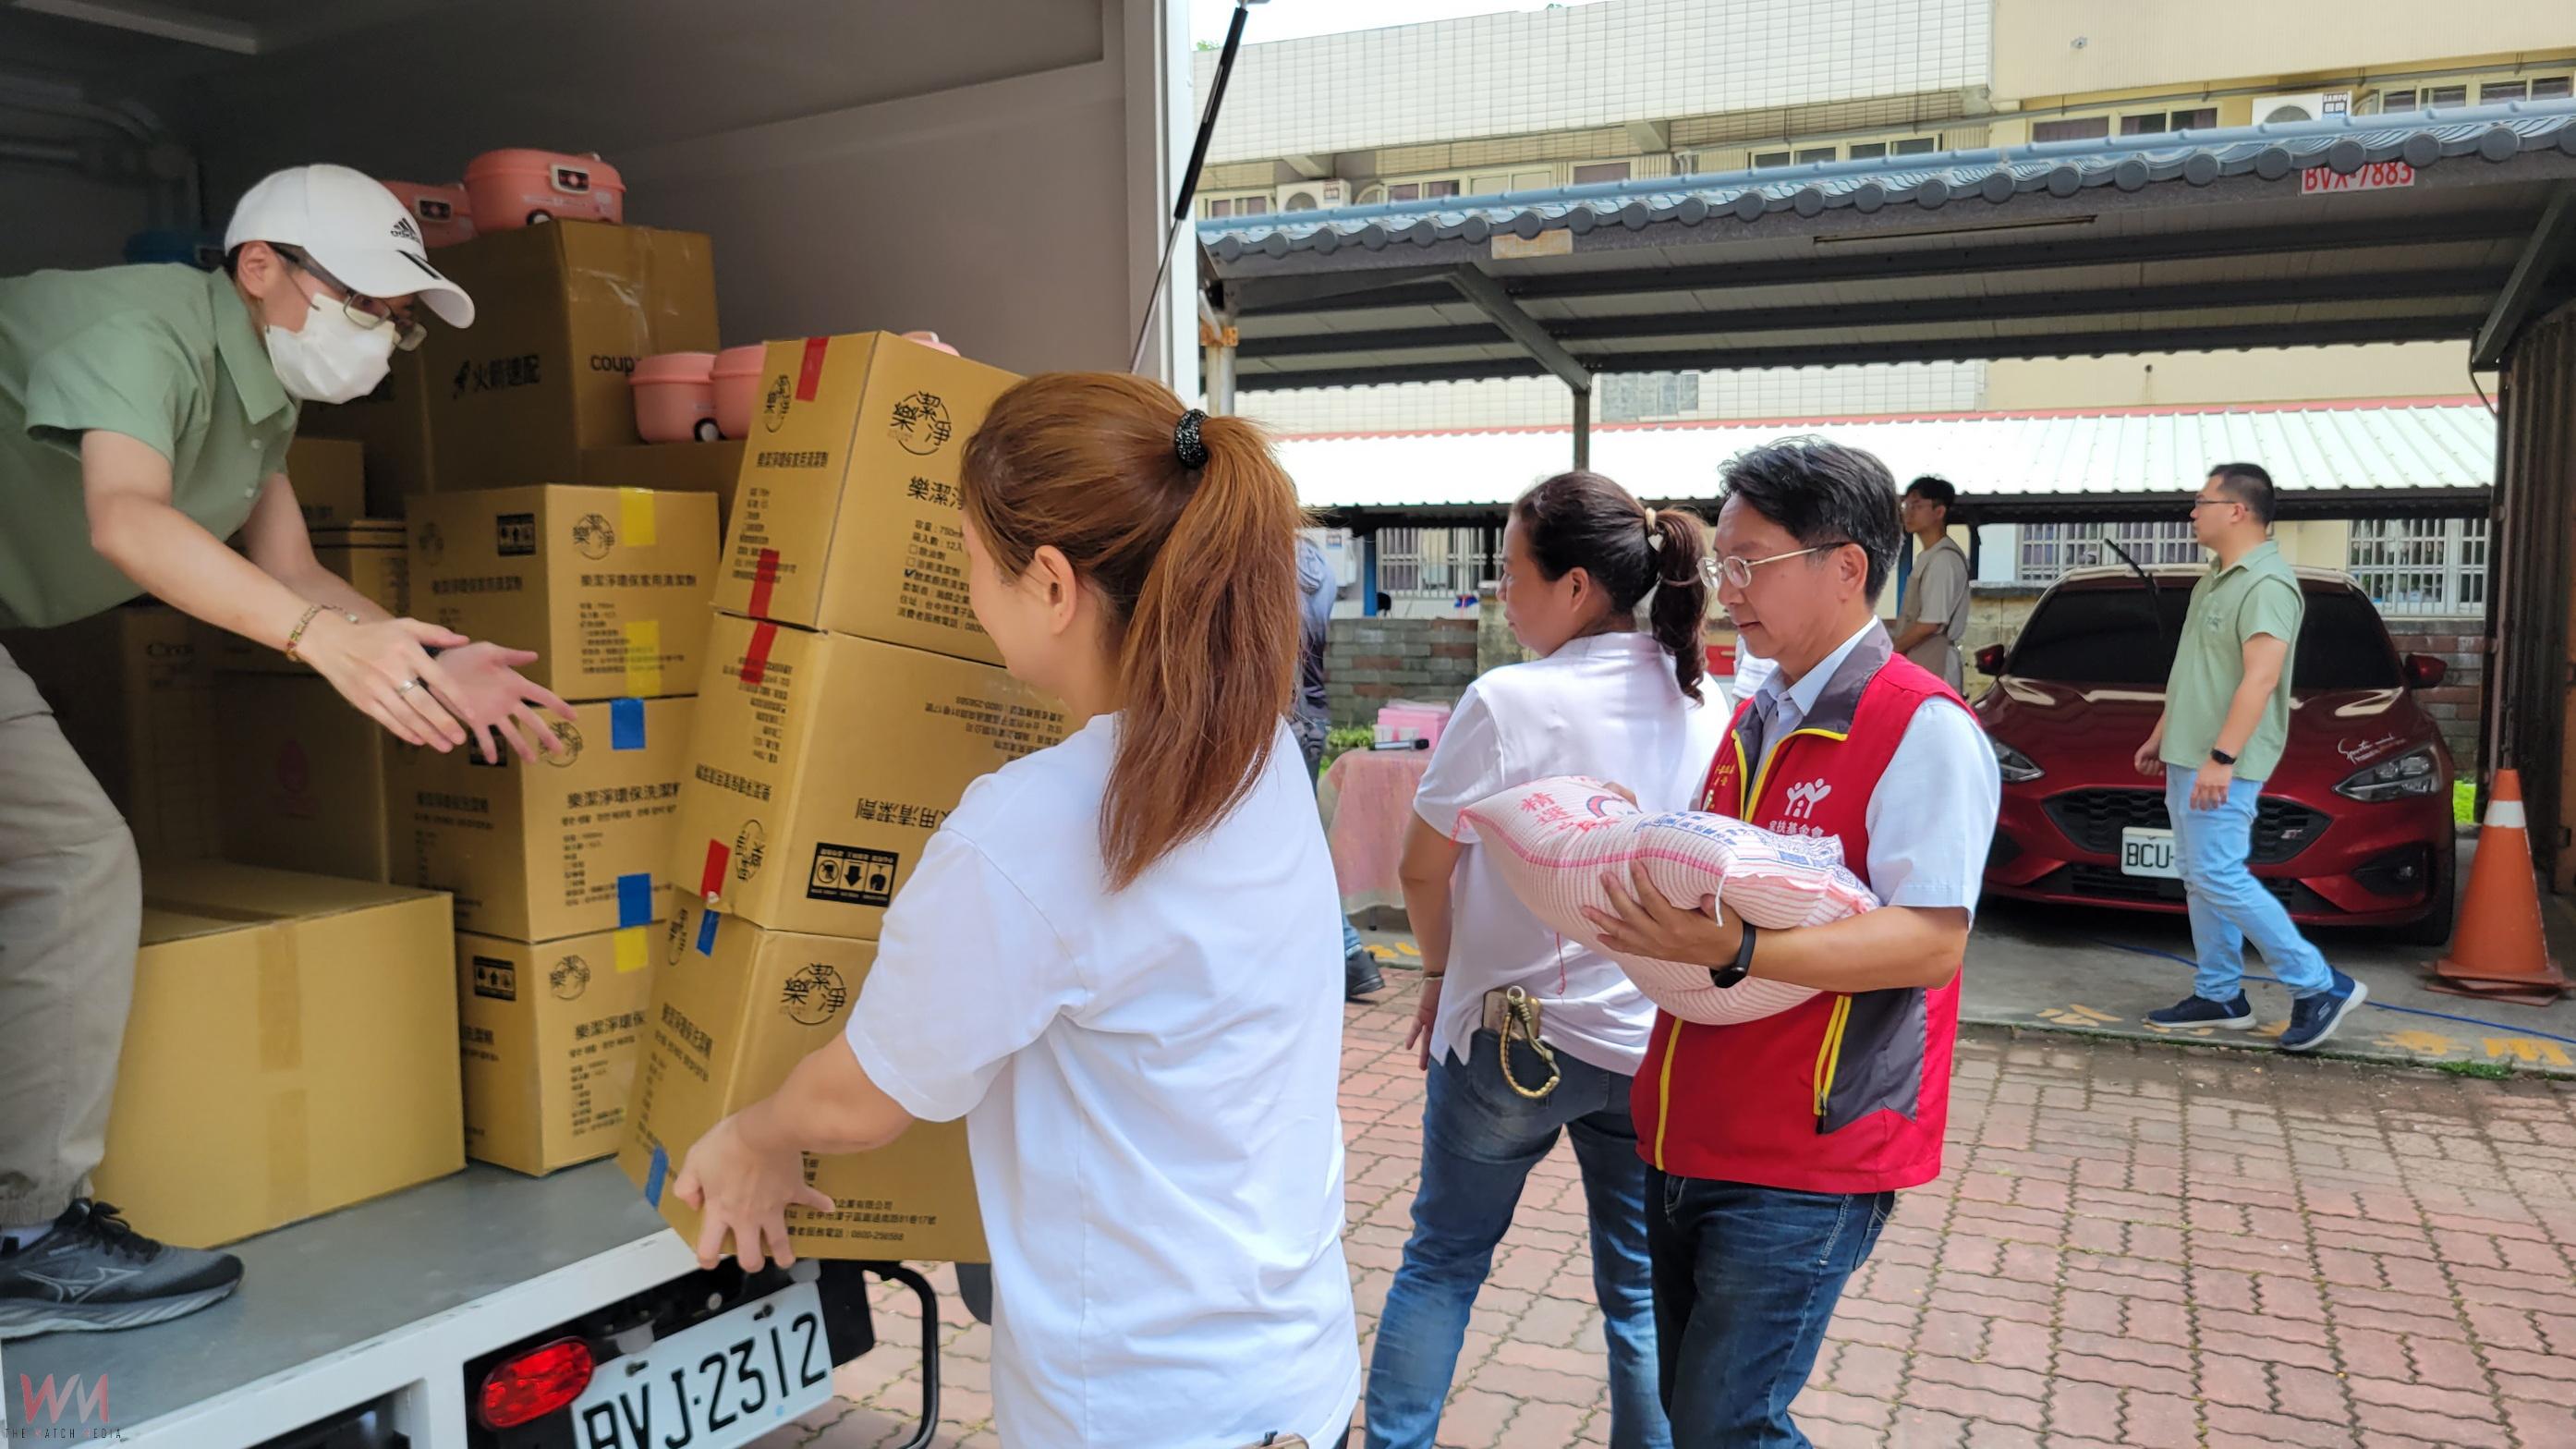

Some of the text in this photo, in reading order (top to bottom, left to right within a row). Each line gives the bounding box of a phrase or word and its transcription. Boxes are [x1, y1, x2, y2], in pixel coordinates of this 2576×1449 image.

[590, 355, 637, 377] coup
[890, 390, 953, 446] 樂潔淨
[2125, 842, 2174, 869] BCU-
[780, 962, 847, 1014] 樂潔淨
